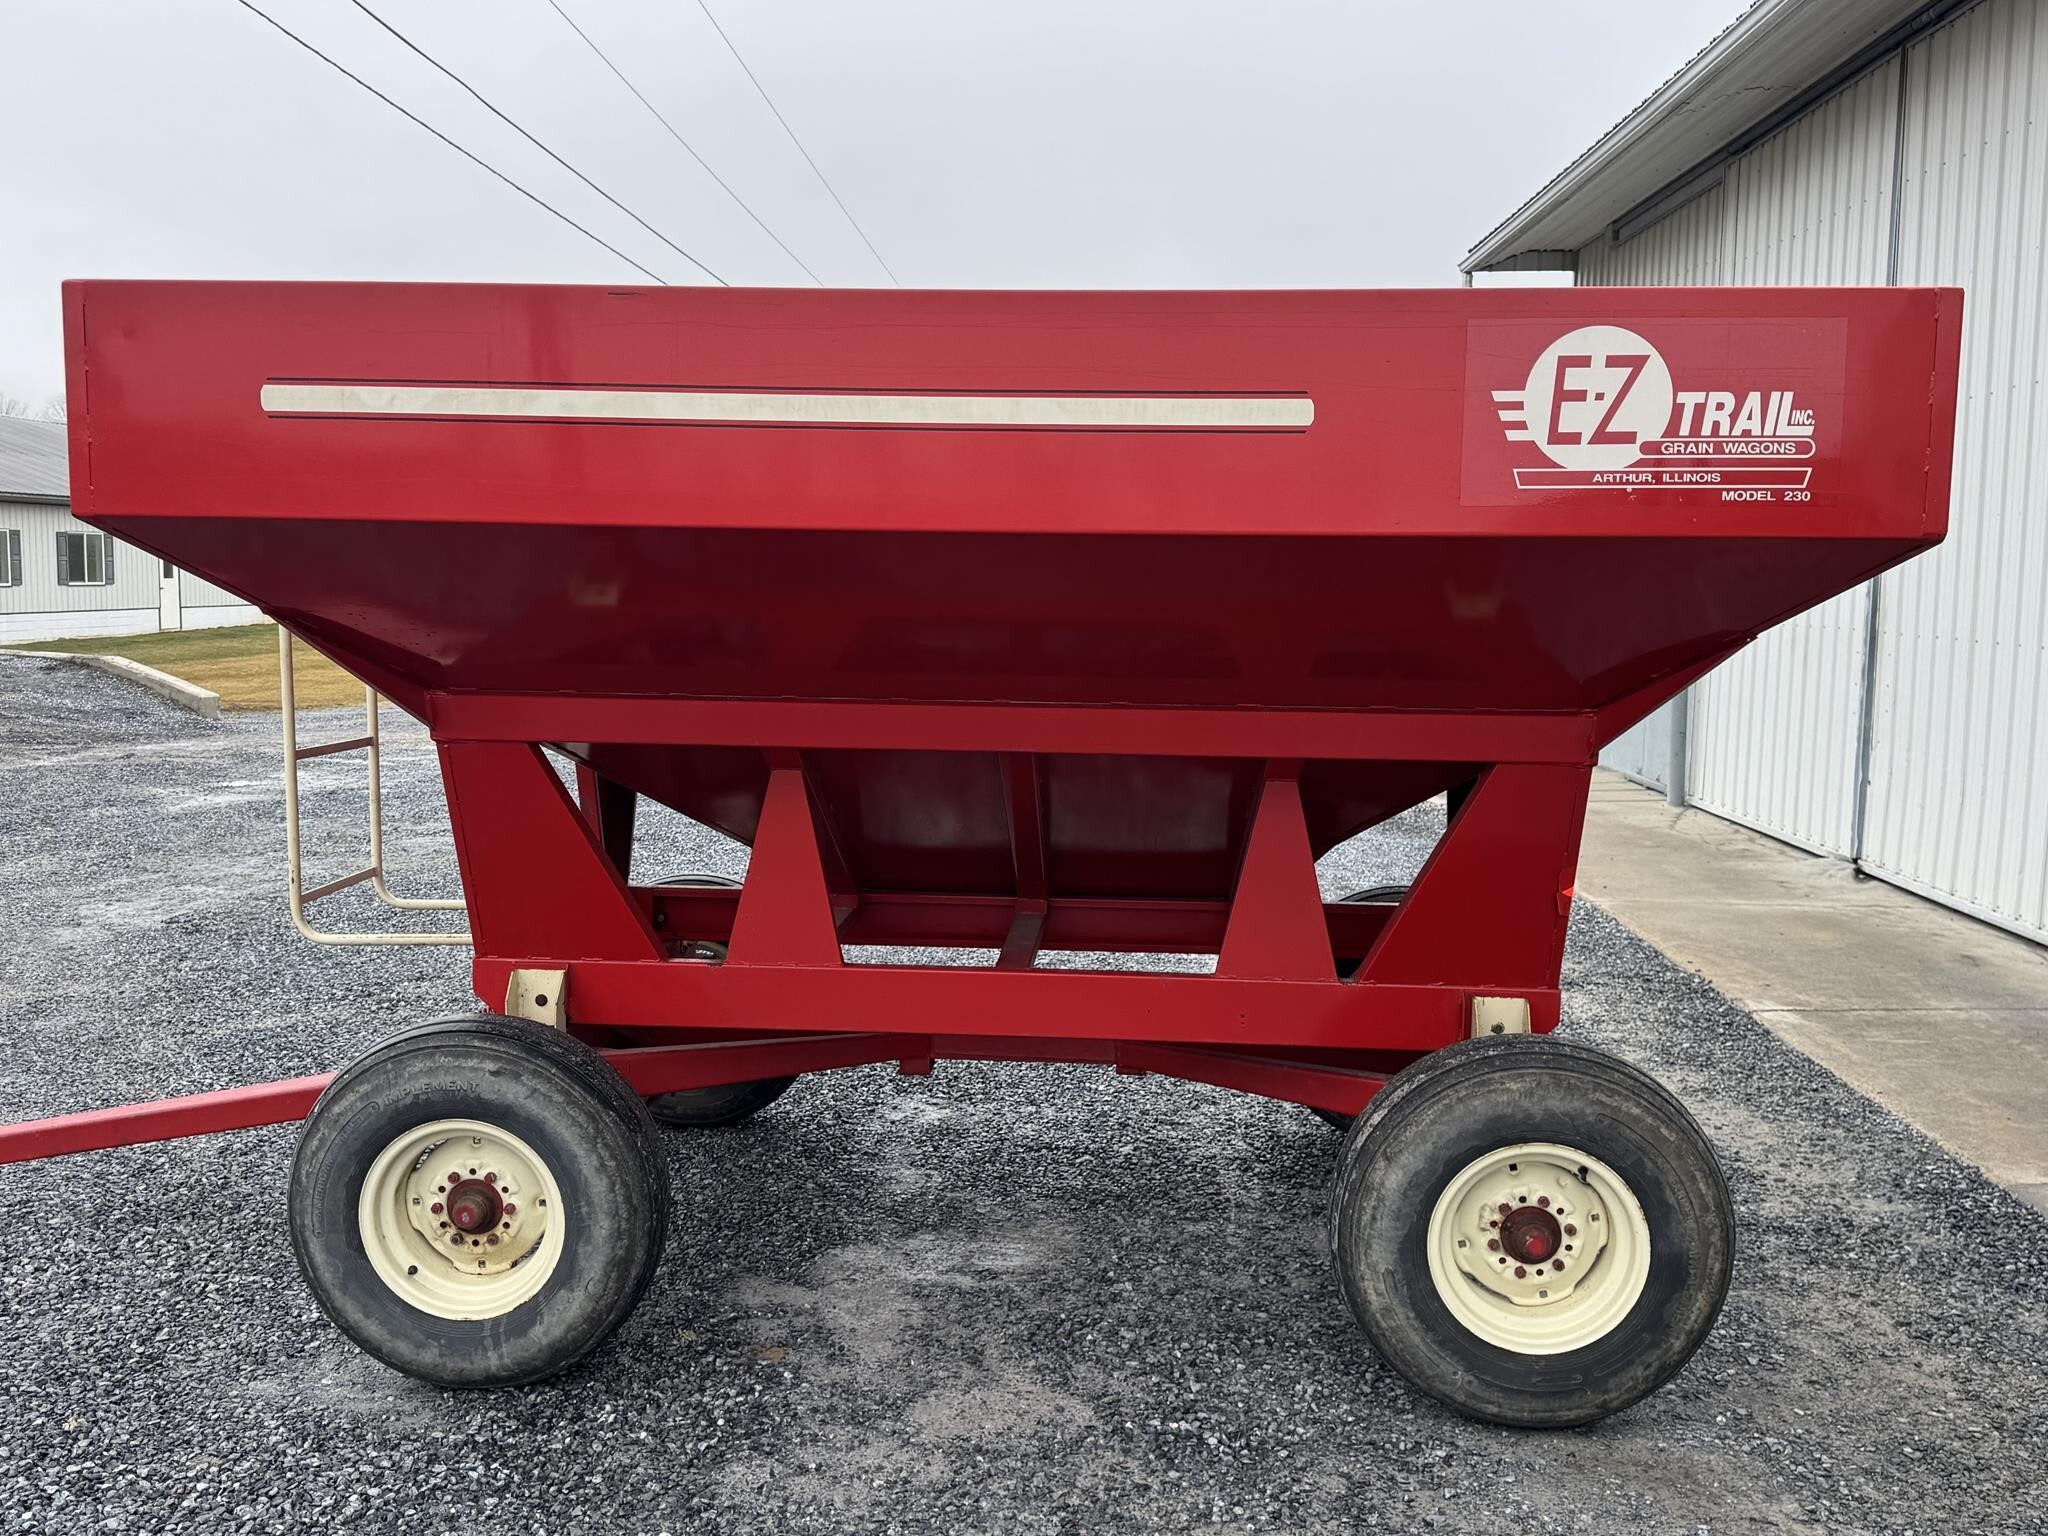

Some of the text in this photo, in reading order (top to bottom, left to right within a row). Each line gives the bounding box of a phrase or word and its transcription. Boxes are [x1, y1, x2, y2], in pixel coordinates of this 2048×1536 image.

[1676, 391, 1815, 437] TRAIL
[1790, 409, 1816, 425] INC.
[1660, 442, 1797, 455] GRAIN WAGONS
[1592, 472, 1722, 484] ARTHUR, ILLINOIS
[1721, 490, 1812, 502] MODEL 230
[382, 1079, 480, 1105] IMPLEMENT
